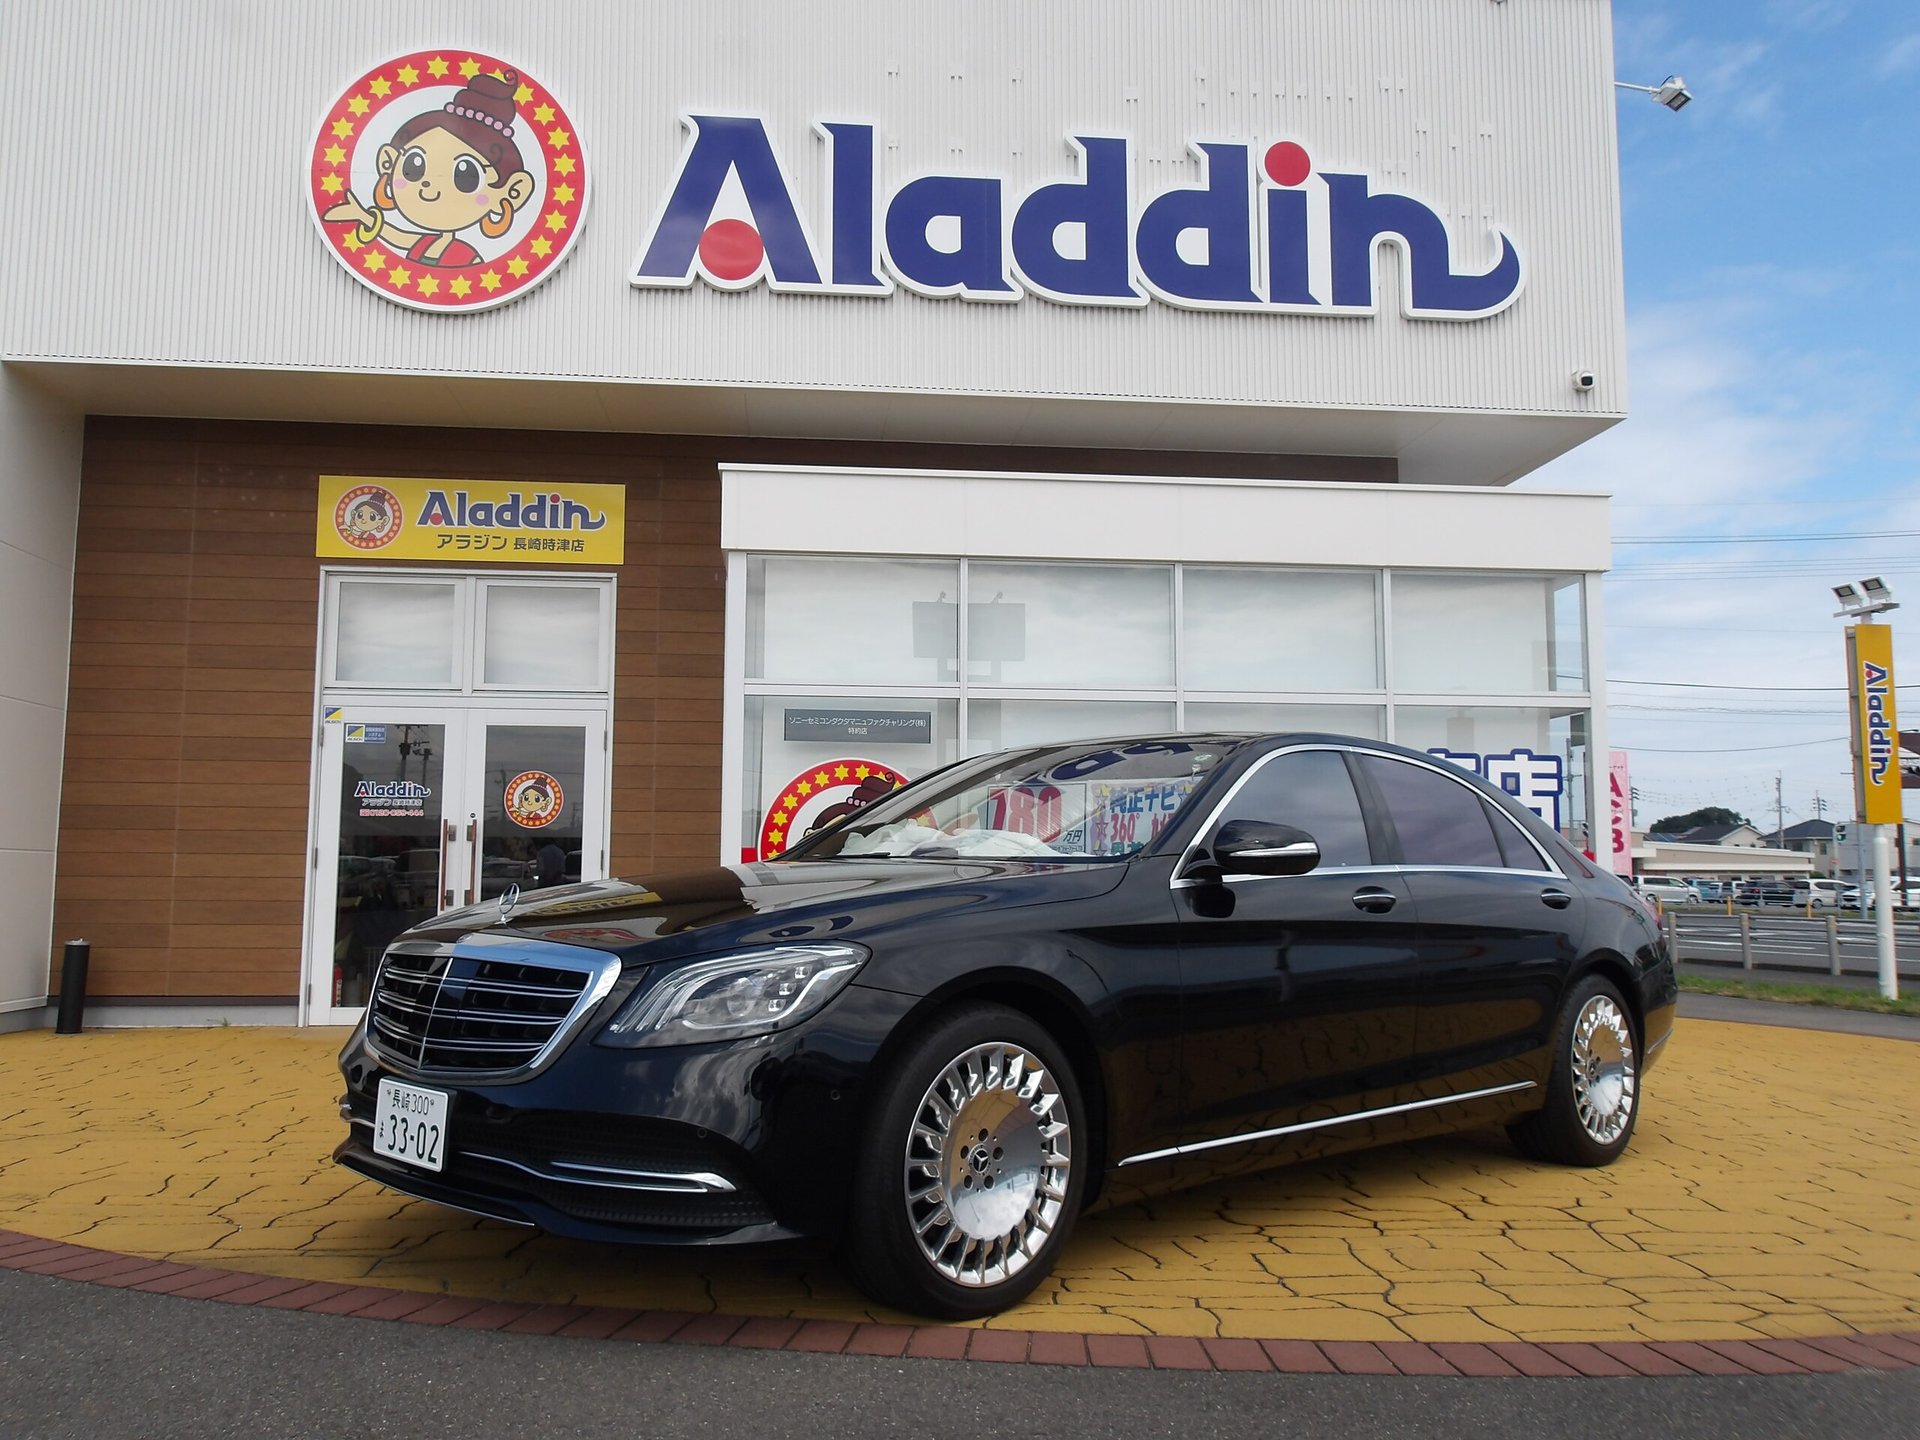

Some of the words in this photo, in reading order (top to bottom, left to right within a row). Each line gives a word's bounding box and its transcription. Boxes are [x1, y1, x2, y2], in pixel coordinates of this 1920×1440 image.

[634, 115, 1522, 318] Aladdin
[417, 491, 606, 530] Aladdin
[437, 534, 507, 550] アラジン
[513, 537, 585, 552] 長崎時津店
[848, 727, 868, 735] 特約店
[1864, 661, 1892, 786] Aladdin
[354, 781, 432, 798] Aladdin
[1427, 748, 1563, 833] 店
[1063, 829, 1083, 842] 万円
[392, 1089, 410, 1111] 長崎
[411, 1094, 430, 1115] 300
[388, 1114, 439, 1164] 33-02
